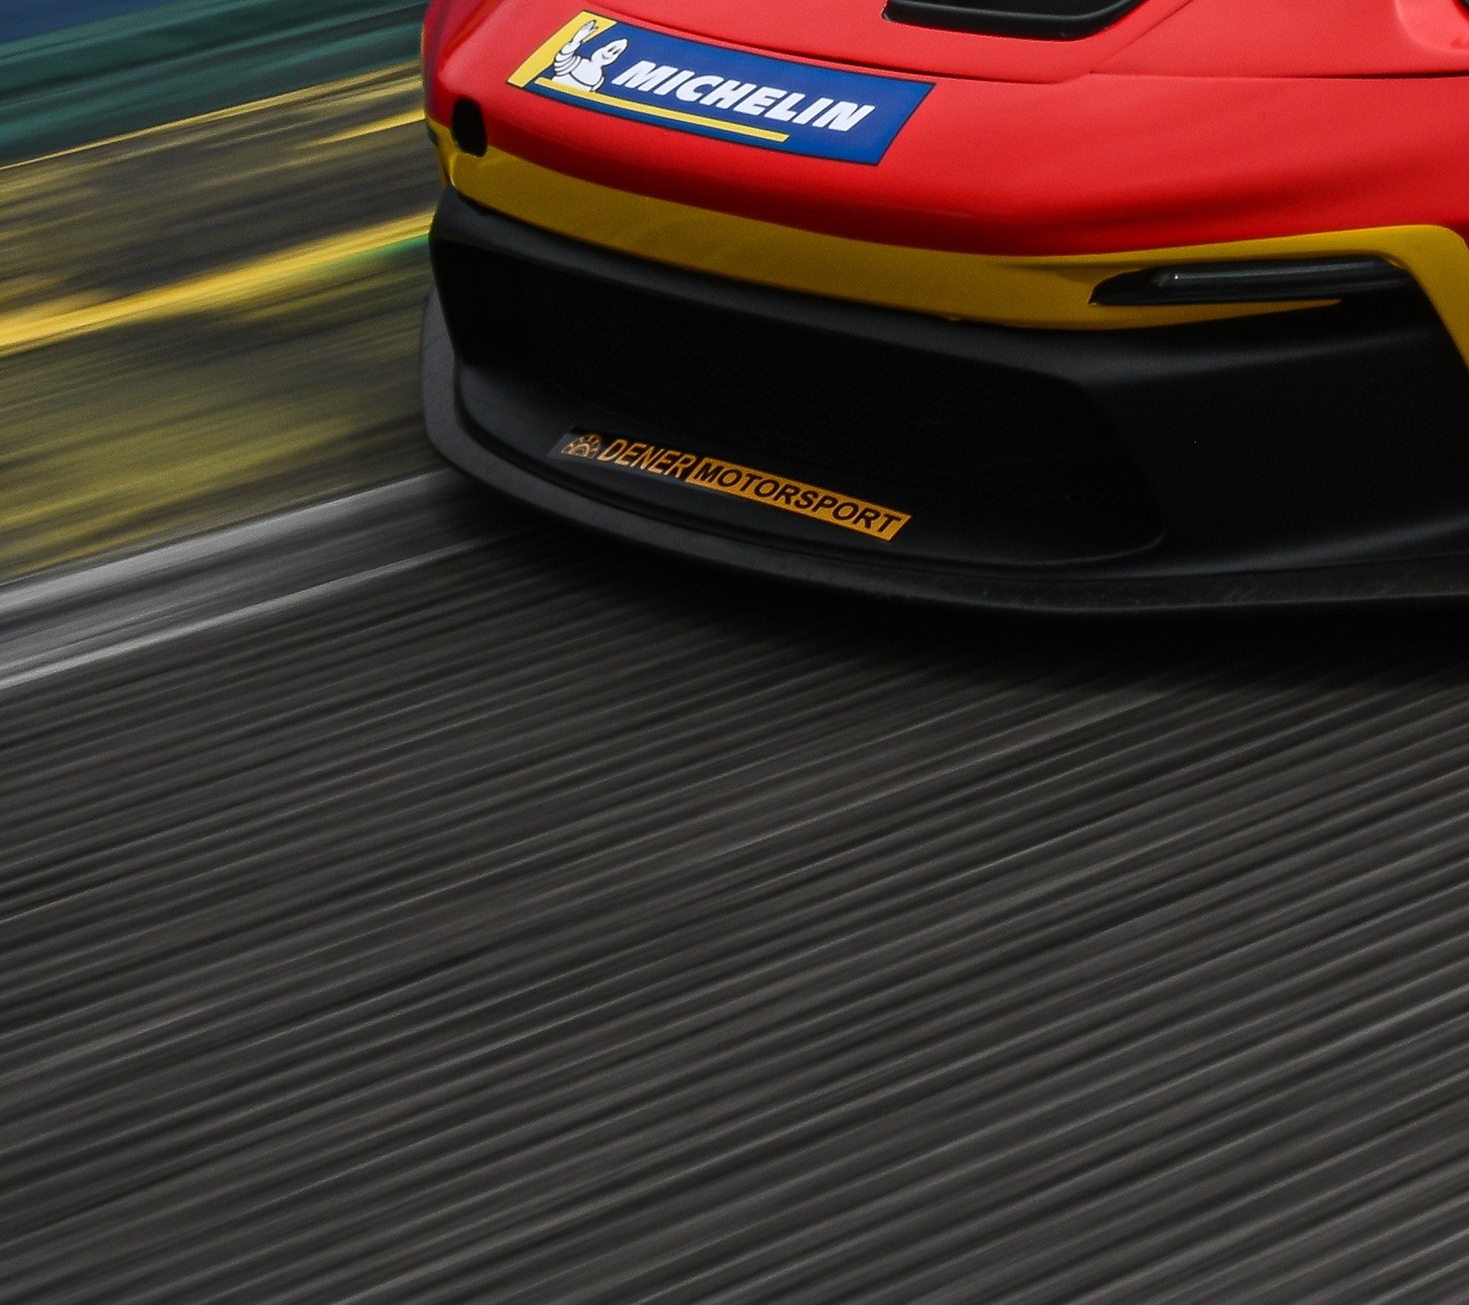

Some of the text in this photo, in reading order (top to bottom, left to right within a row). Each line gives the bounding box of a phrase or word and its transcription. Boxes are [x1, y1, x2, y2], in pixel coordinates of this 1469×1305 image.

[612, 61, 875, 132] MICHELIN
[597, 439, 902, 536] DENER MOTORSPORT
